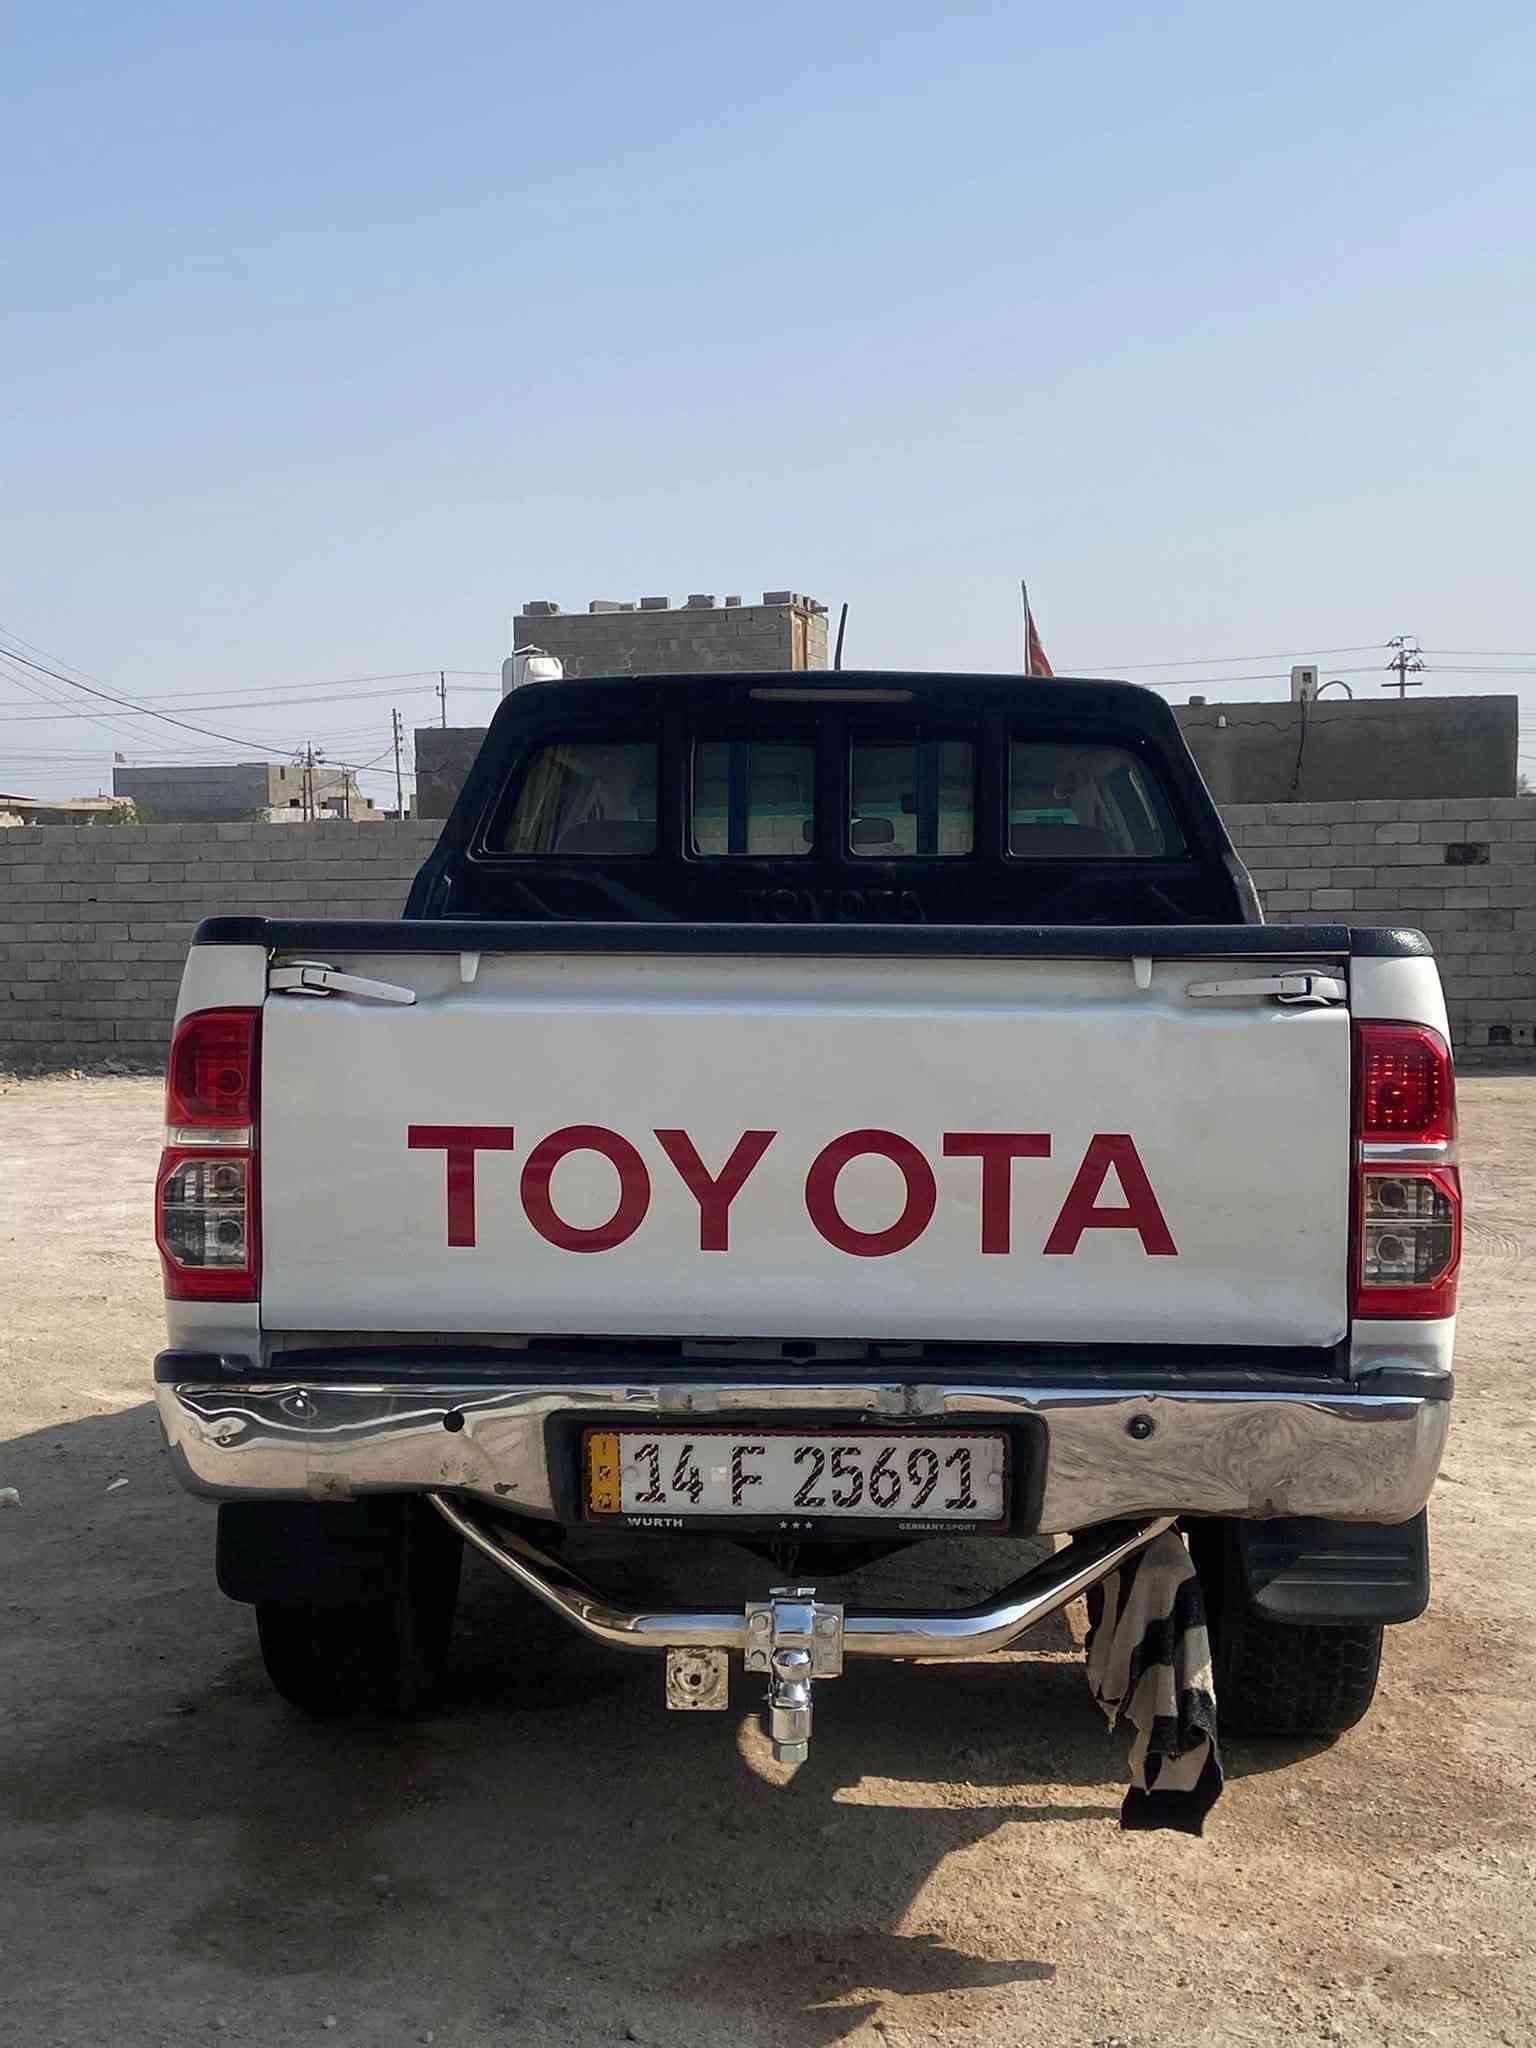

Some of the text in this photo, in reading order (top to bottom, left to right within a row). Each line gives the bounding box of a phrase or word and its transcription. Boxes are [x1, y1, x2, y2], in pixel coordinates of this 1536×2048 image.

[408, 1125, 1179, 1257] TOYOTA
[634, 1443, 704, 1503] 14
[731, 1446, 765, 1505] F
[793, 1446, 977, 1510] 25691
